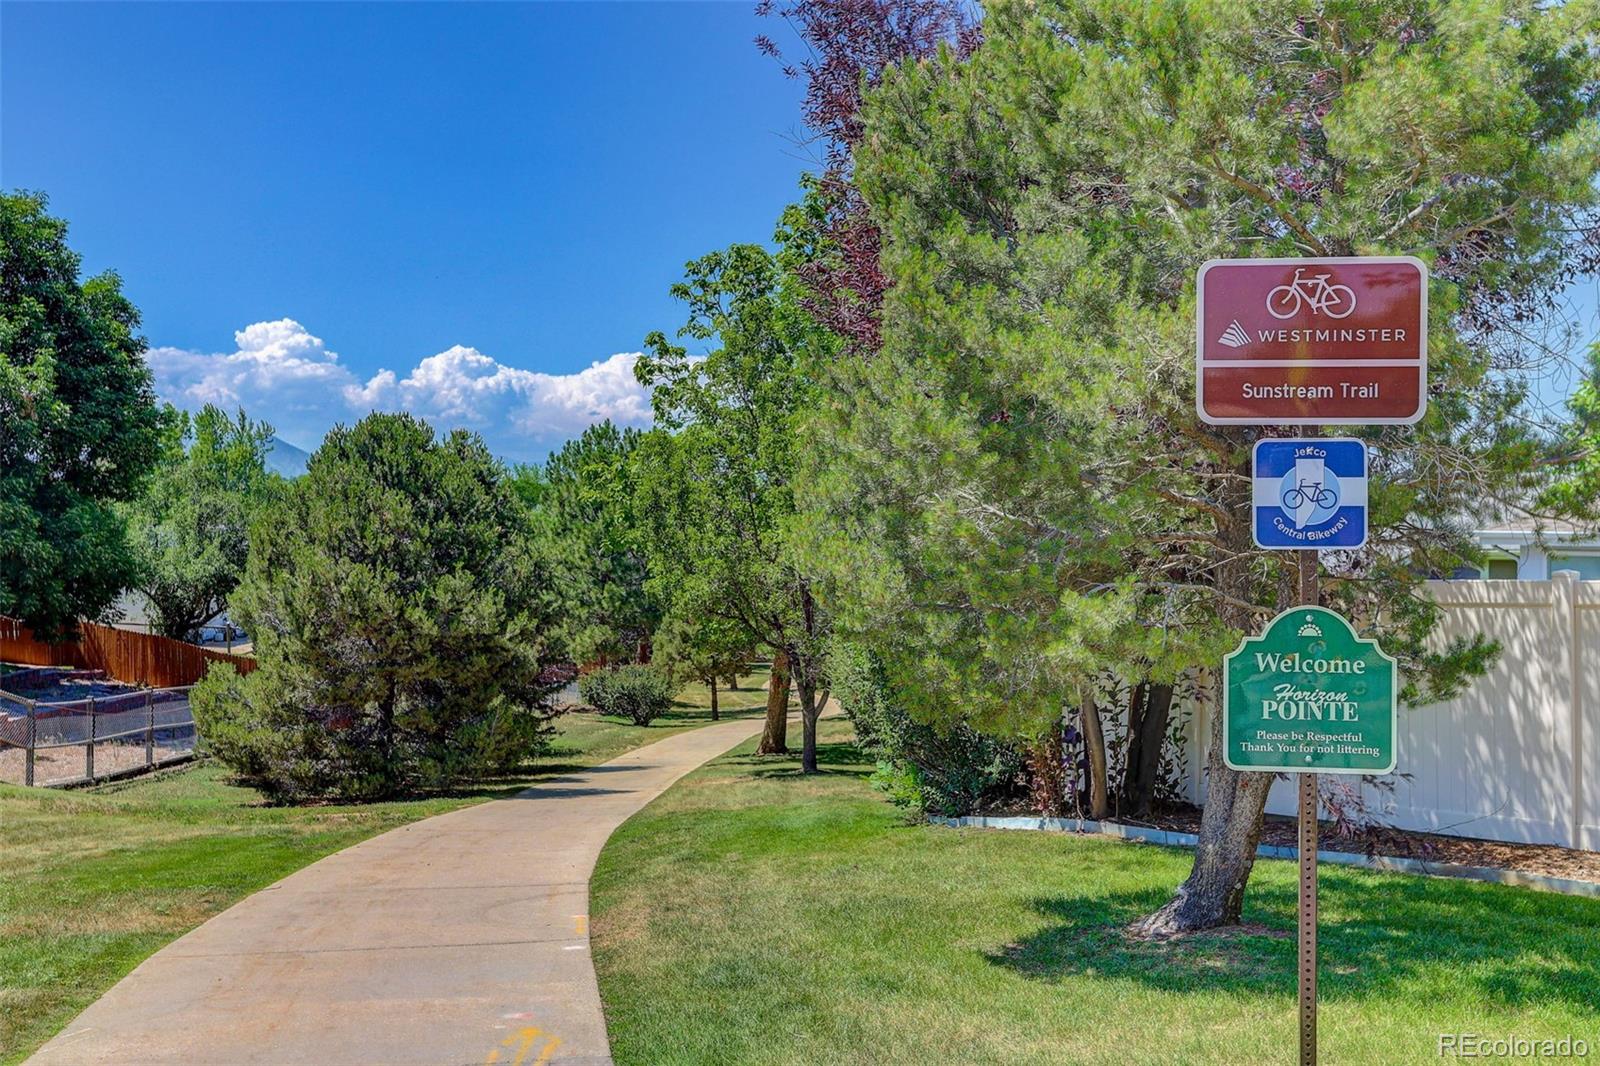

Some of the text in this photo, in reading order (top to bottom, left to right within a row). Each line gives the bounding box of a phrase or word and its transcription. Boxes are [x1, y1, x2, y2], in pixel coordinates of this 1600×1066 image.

[1258, 328, 1406, 343] WESTMINSTER
[1242, 382, 1379, 399] Sunstream Trail
[1273, 516, 1349, 541] Central Bikeway
[1255, 652, 1366, 674] Welcome
[1273, 683, 1348, 706] Horizon
[1261, 700, 1359, 722] POINTE
[1256, 730, 1362, 743] Please be Respectful
[1240, 742, 1380, 757] Thank You for not littering
